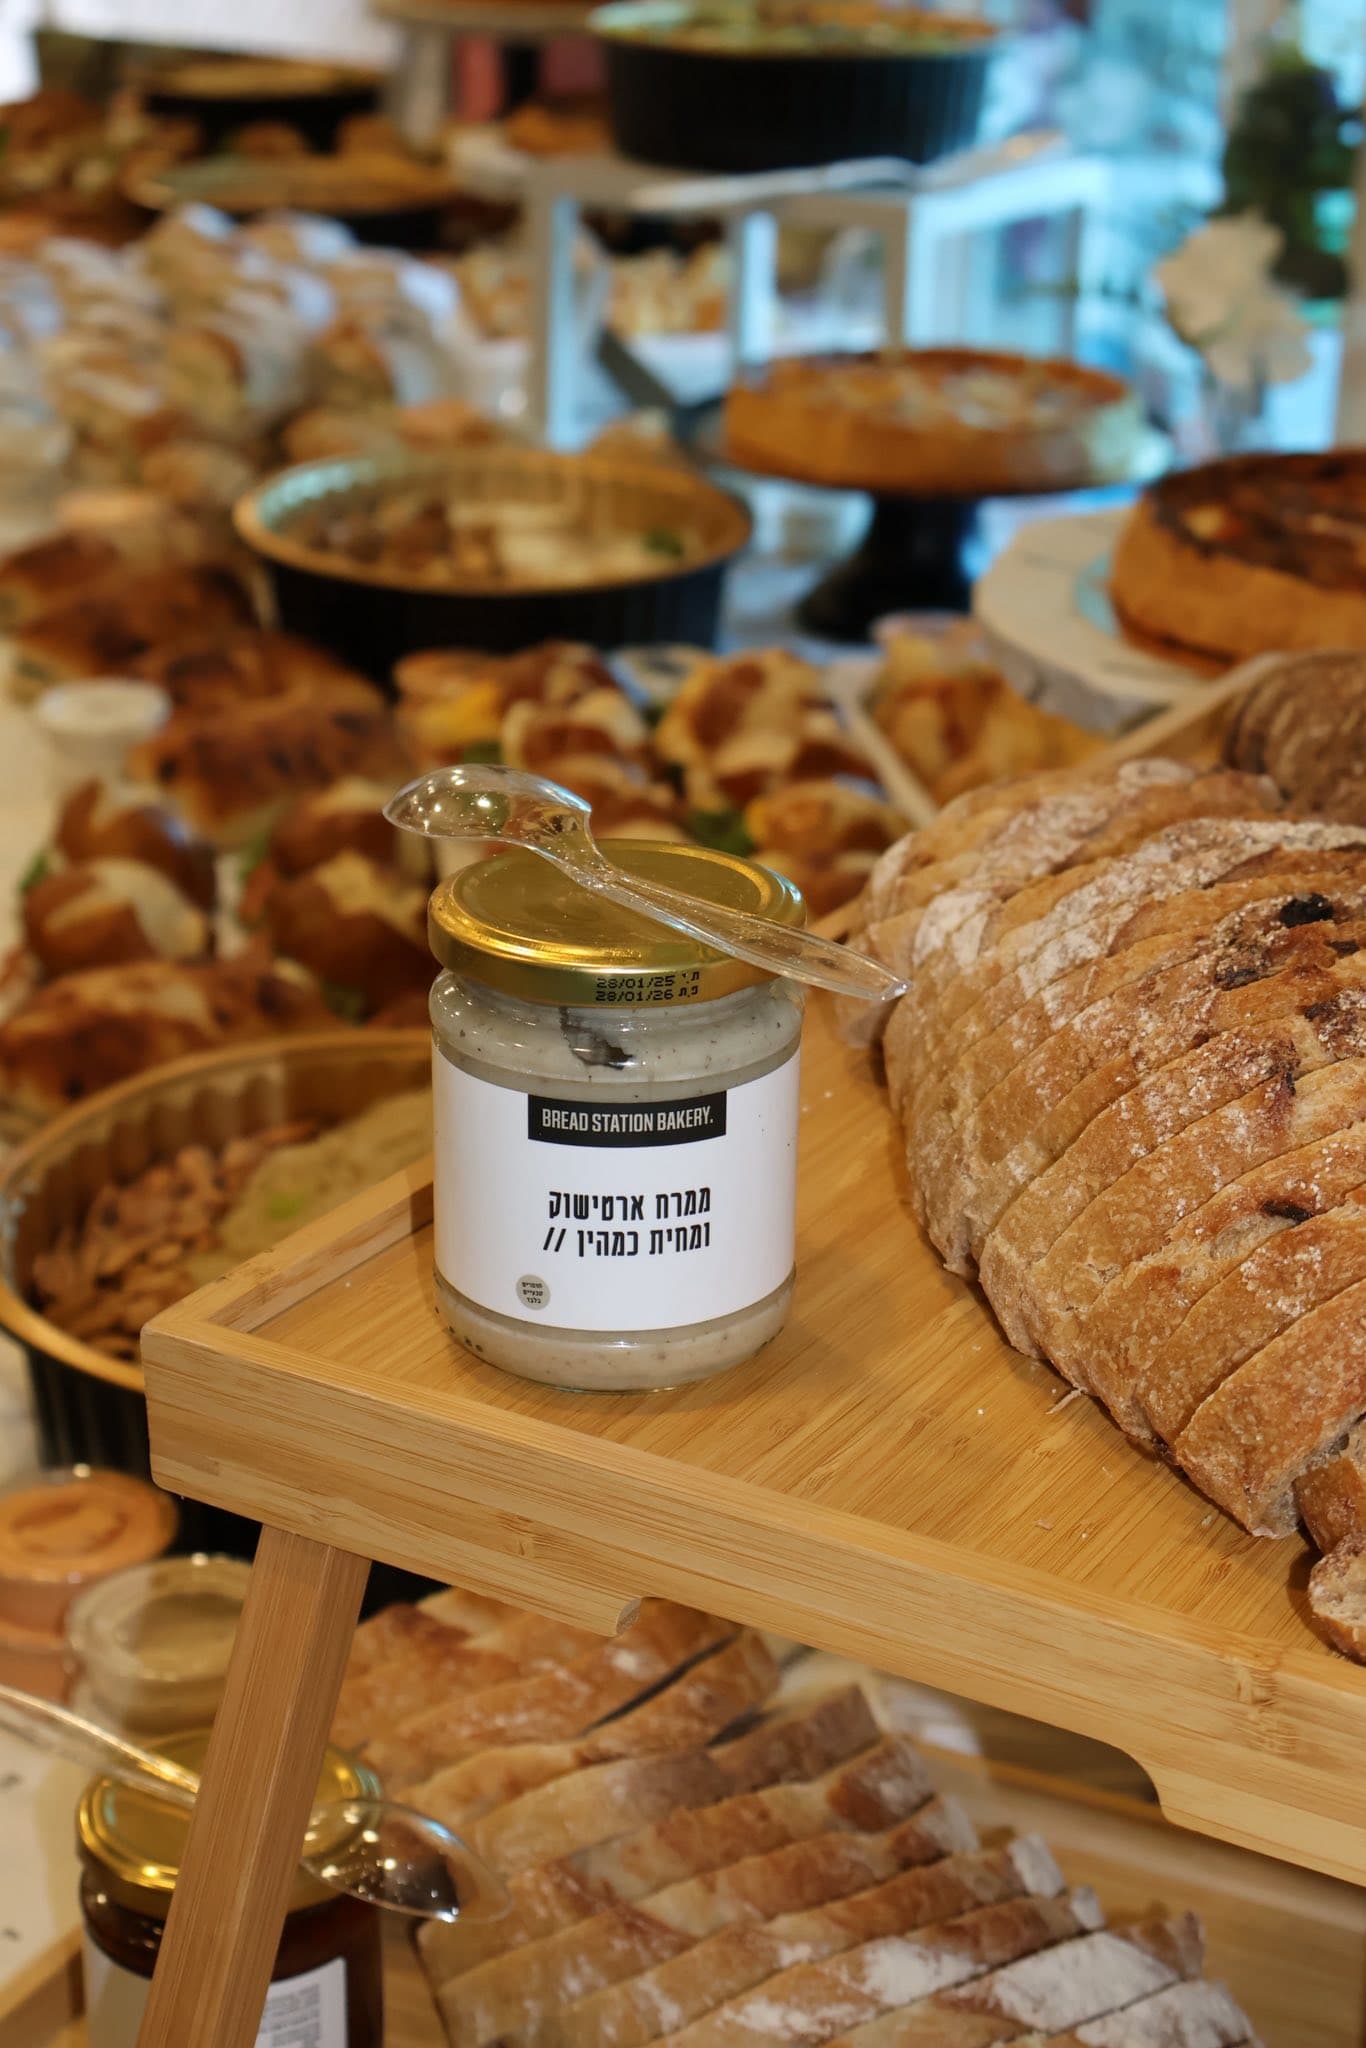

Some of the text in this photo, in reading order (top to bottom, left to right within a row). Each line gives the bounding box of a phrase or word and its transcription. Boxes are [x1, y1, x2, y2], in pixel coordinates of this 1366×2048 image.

[595, 989, 674, 1002] 28/01/26
[596, 975, 676, 989] 28/01/25
[542, 1105, 714, 1133] BREAD STATION BAKERY.
[548, 1186, 711, 1221] ממרח ארטישוק
[577, 1230, 639, 1258] כמהין
[649, 1221, 710, 1255] ומחית
